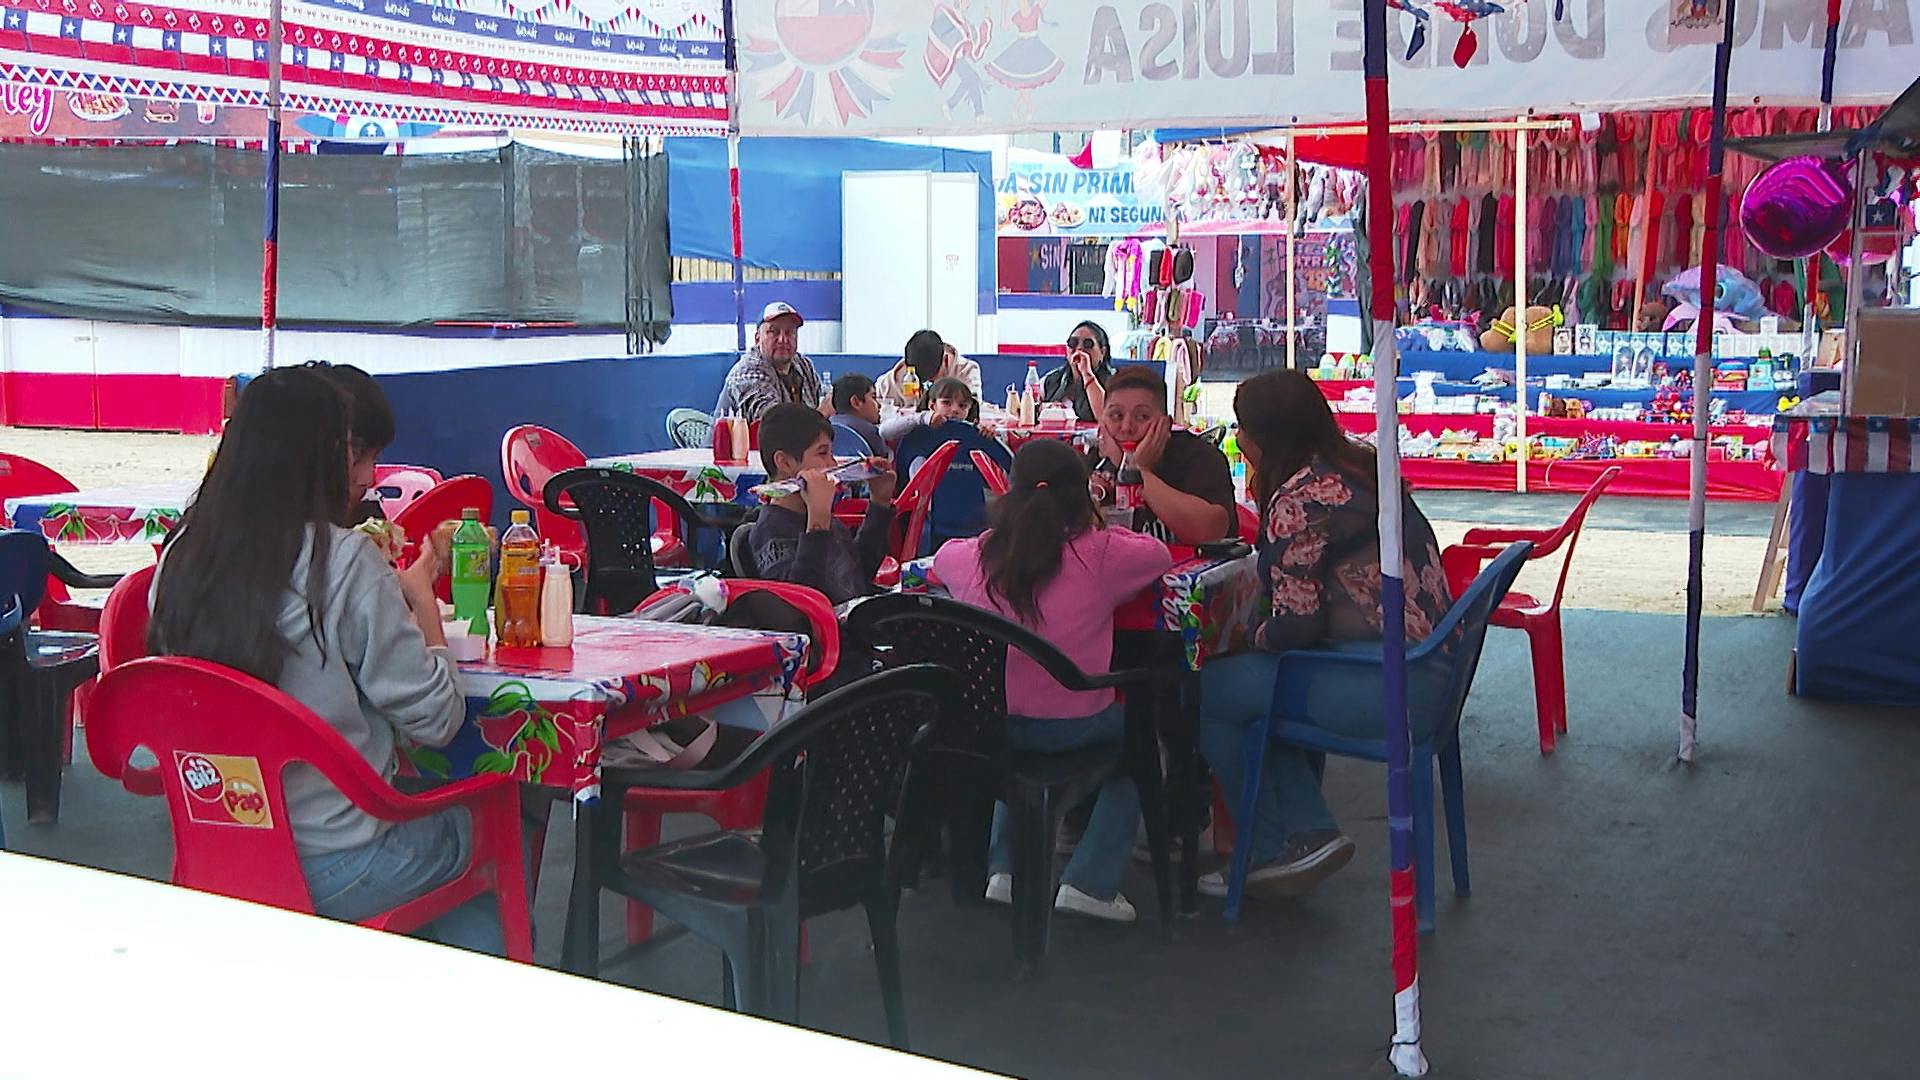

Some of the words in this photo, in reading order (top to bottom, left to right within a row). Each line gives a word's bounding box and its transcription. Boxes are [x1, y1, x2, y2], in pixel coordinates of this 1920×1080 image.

[0, 82, 54, 135] ley
[998, 172, 1018, 193] A
[1029, 172, 1067, 194] SIN
[1073, 171, 1135, 194] PRIM
[1088, 206, 1106, 223] NI
[1111, 206, 1167, 223] SEGUN
